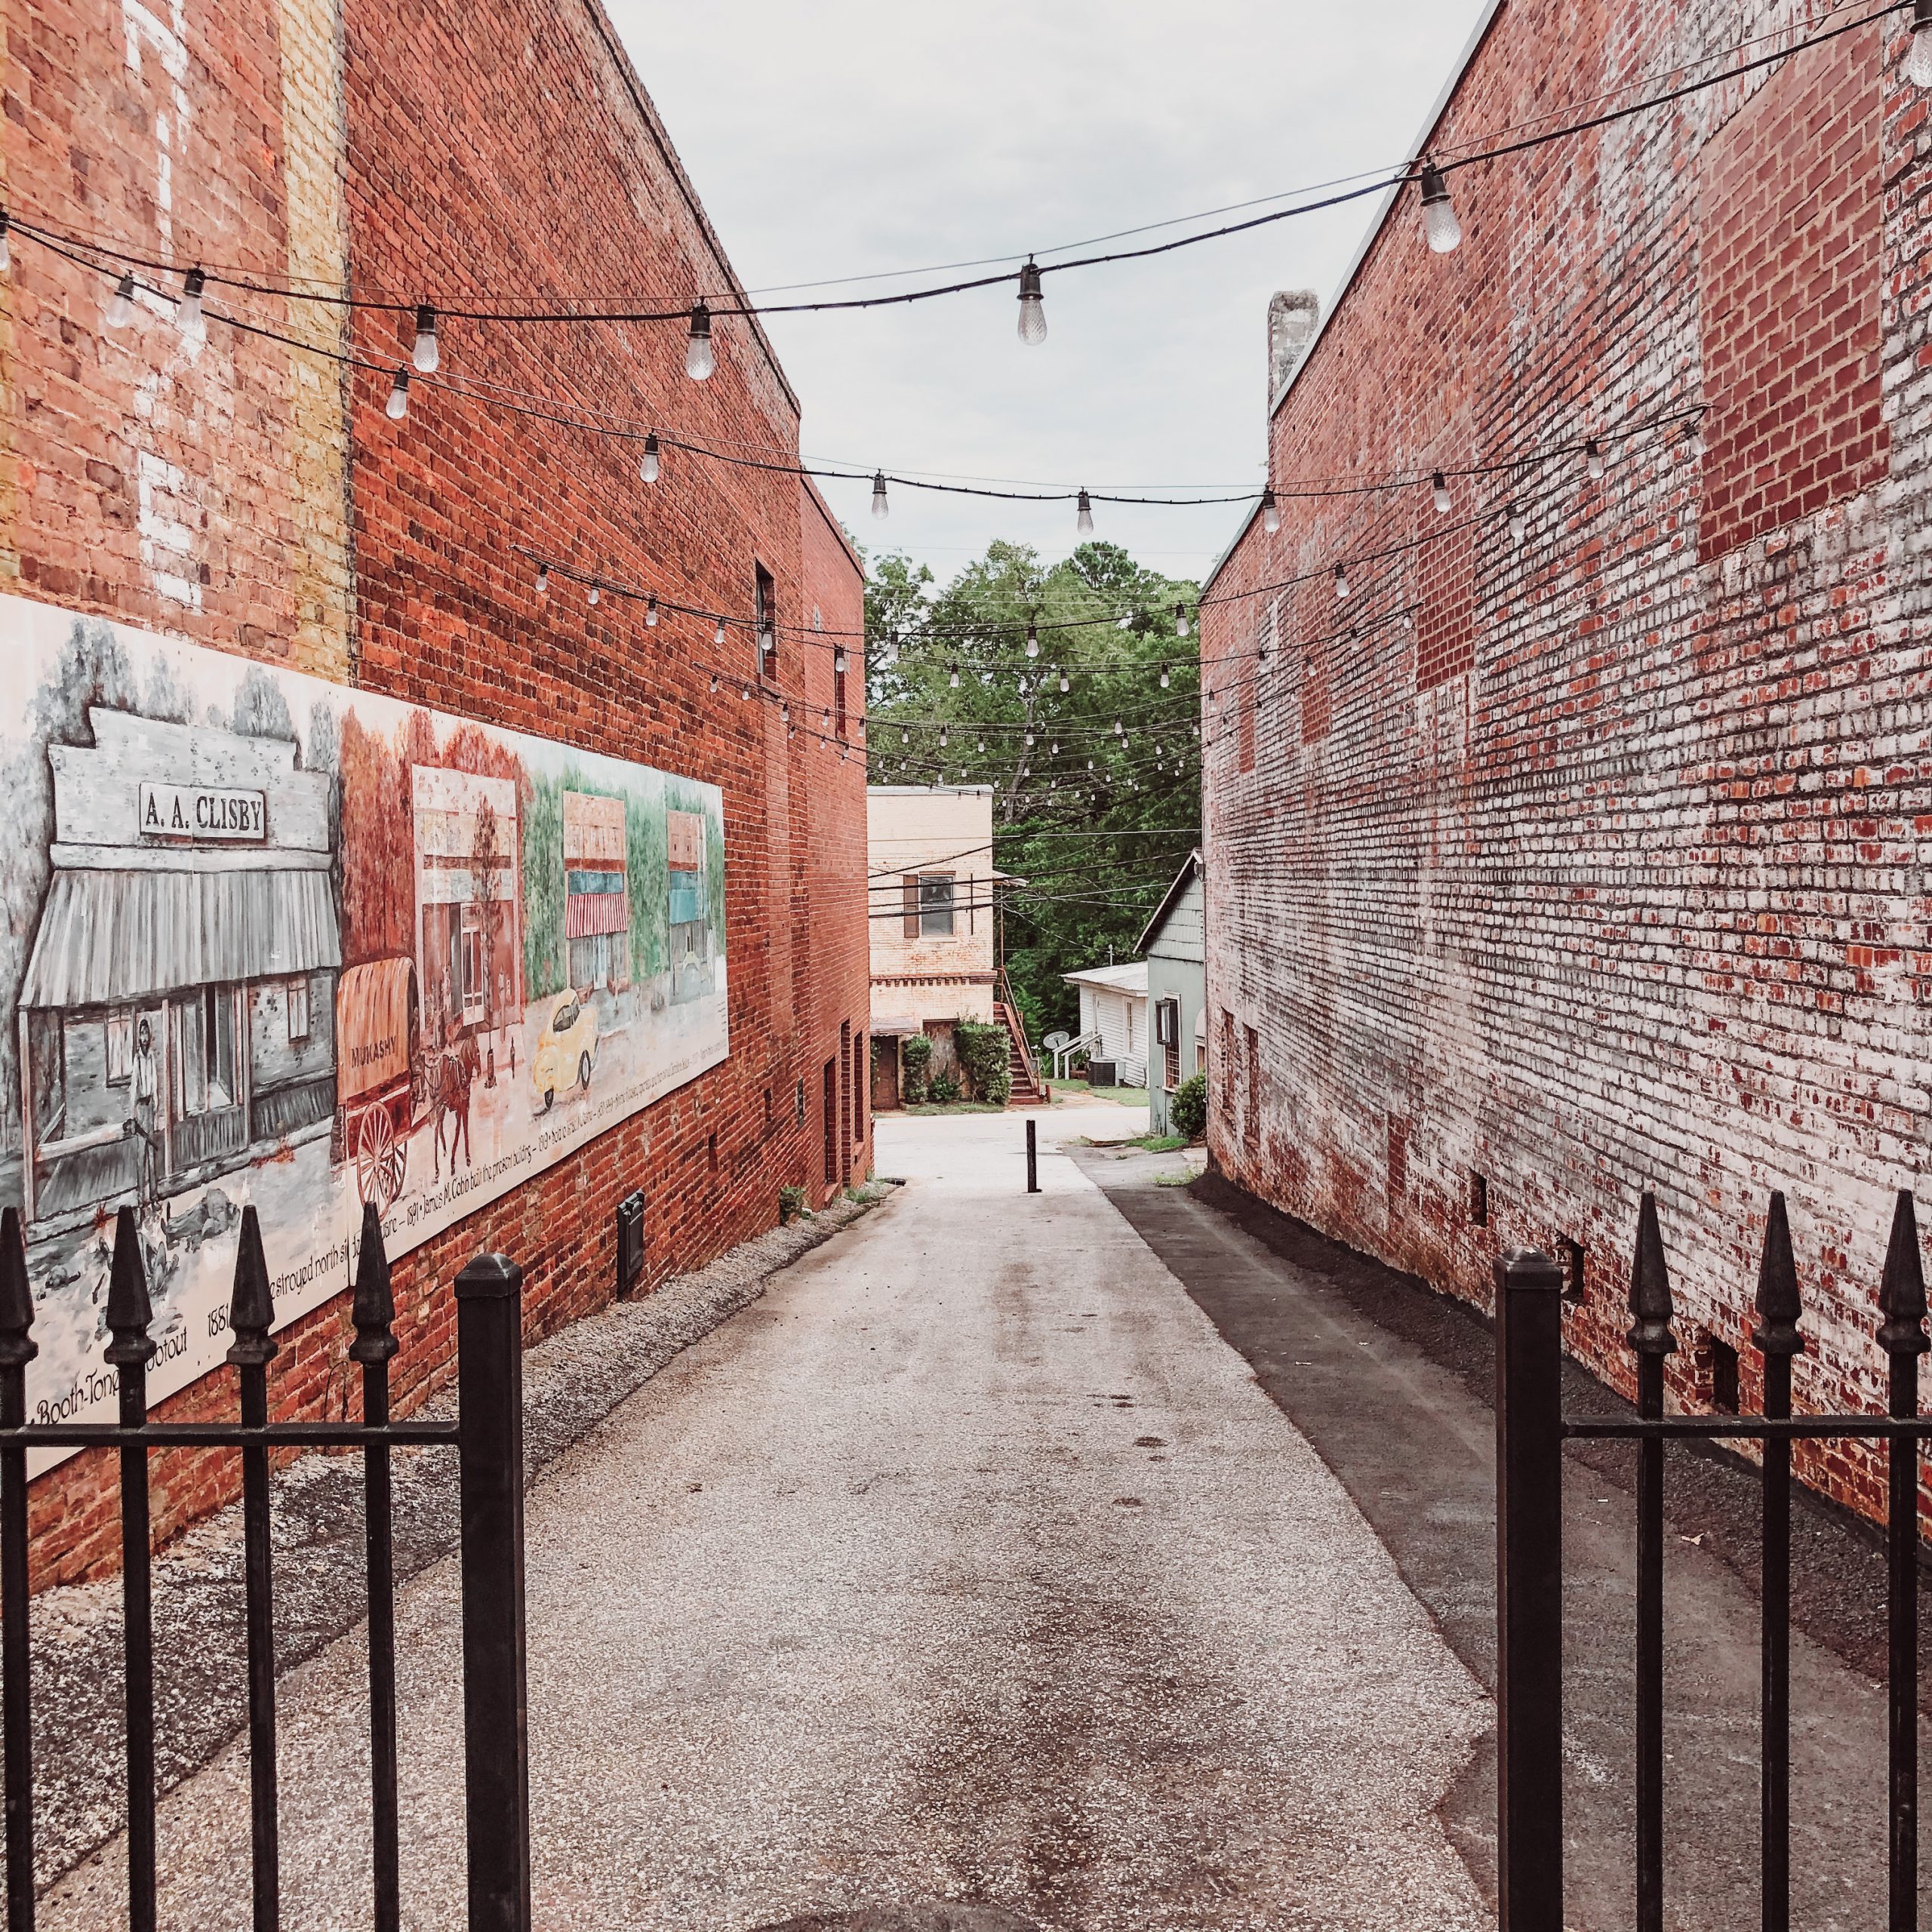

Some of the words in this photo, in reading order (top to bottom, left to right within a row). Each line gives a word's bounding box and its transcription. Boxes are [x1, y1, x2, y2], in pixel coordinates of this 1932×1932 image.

[146, 792, 165, 827] A.
[171, 795, 189, 829] A.
[196, 795, 261, 831] CLISBY
[37, 1367, 119, 1424] Booth-Tone
[269, 1254, 313, 1300] estroyed
[315, 1244, 338, 1277] north
[423, 1194, 443, 1220] James
